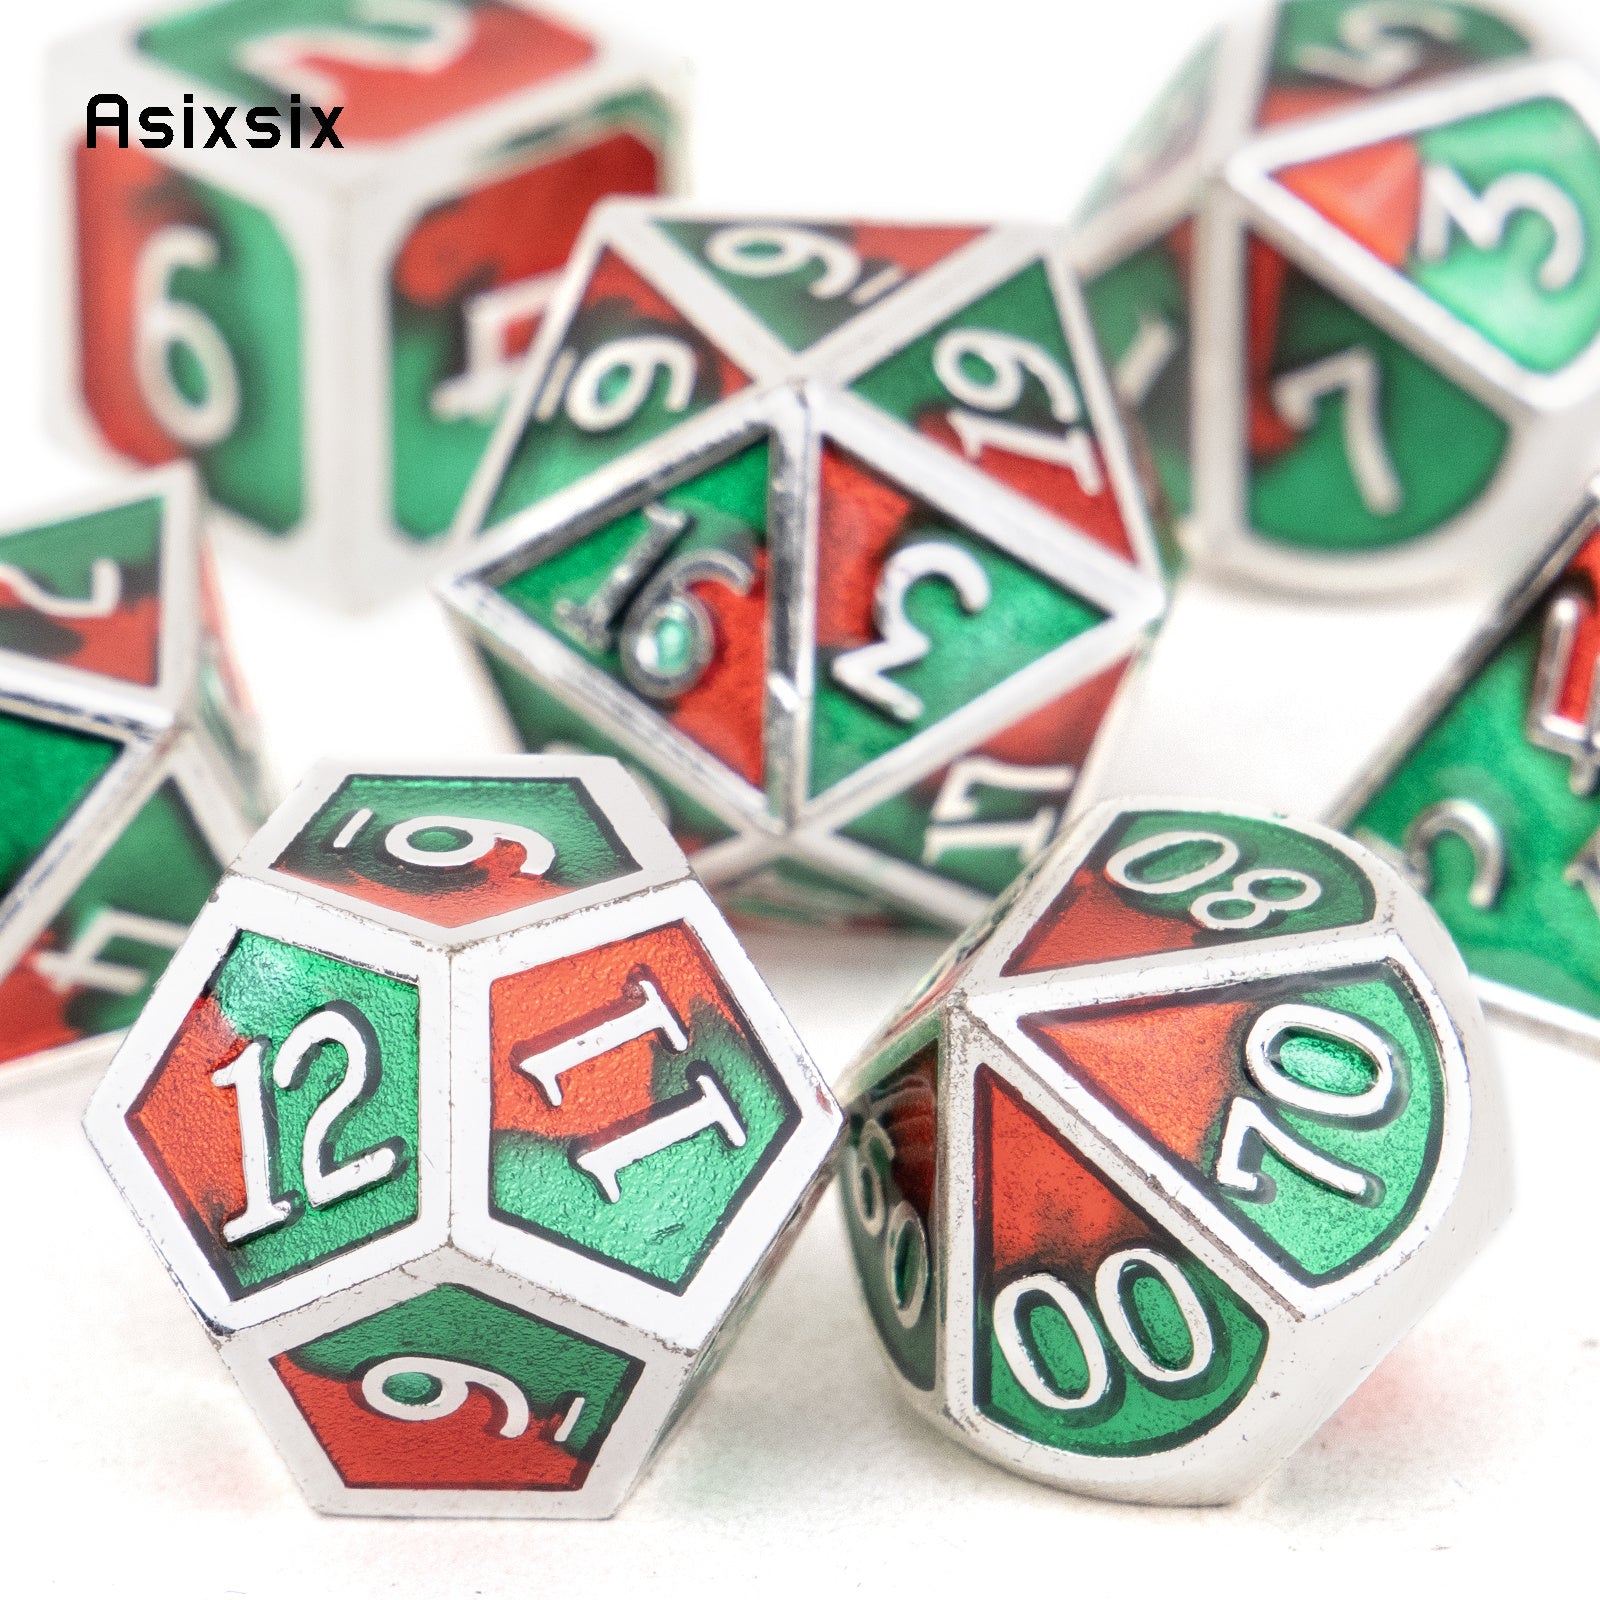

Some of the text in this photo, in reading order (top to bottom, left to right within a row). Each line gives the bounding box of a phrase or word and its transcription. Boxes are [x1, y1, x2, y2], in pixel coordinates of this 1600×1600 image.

[1416, 162, 1588, 292] 3
[134, 226, 242, 448] 6
[932, 329, 1105, 497] 19
[1272, 345, 1403, 516] 7
[552, 501, 758, 700] 16
[831, 540, 993, 724] 3
[921, 755, 1076, 868] 17
[1104, 829, 1324, 930] 80
[212, 1008, 402, 1246] 12
[518, 978, 750, 1206] 11
[1215, 1002, 1395, 1200] 70
[992, 1248, 1216, 1410] 00
